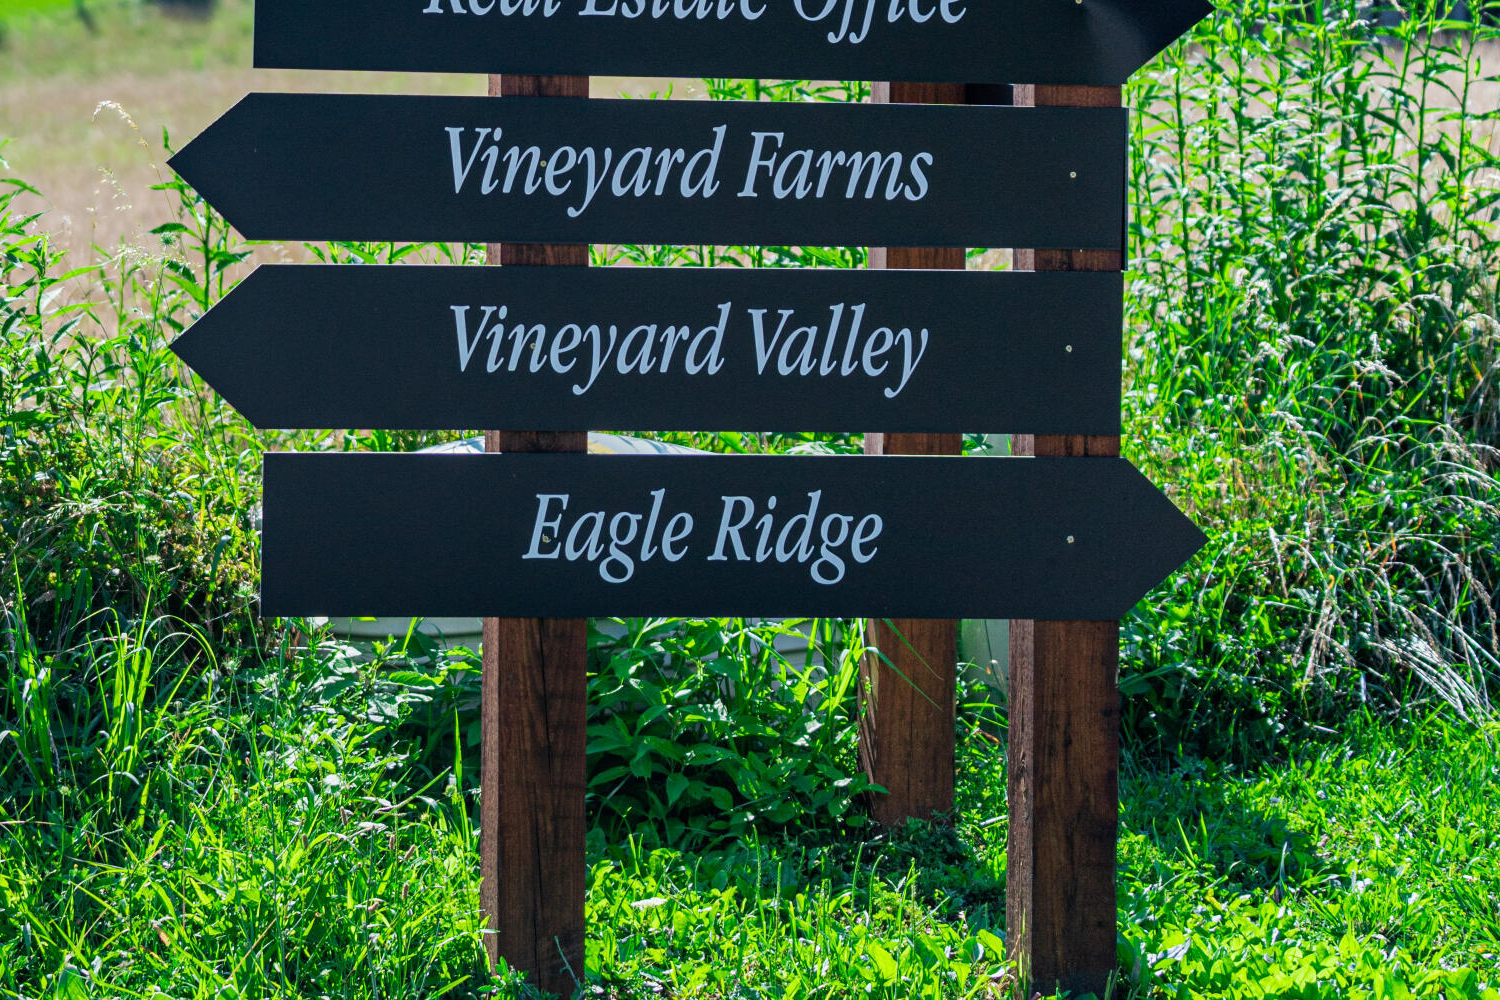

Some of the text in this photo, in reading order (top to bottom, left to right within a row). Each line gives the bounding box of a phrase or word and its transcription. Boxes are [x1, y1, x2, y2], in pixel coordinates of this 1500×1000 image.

[444, 124, 933, 218] Vineyard Farms
[449, 301, 929, 399] Vineyard Valley
[522, 487, 883, 585] Eagle Ridge
